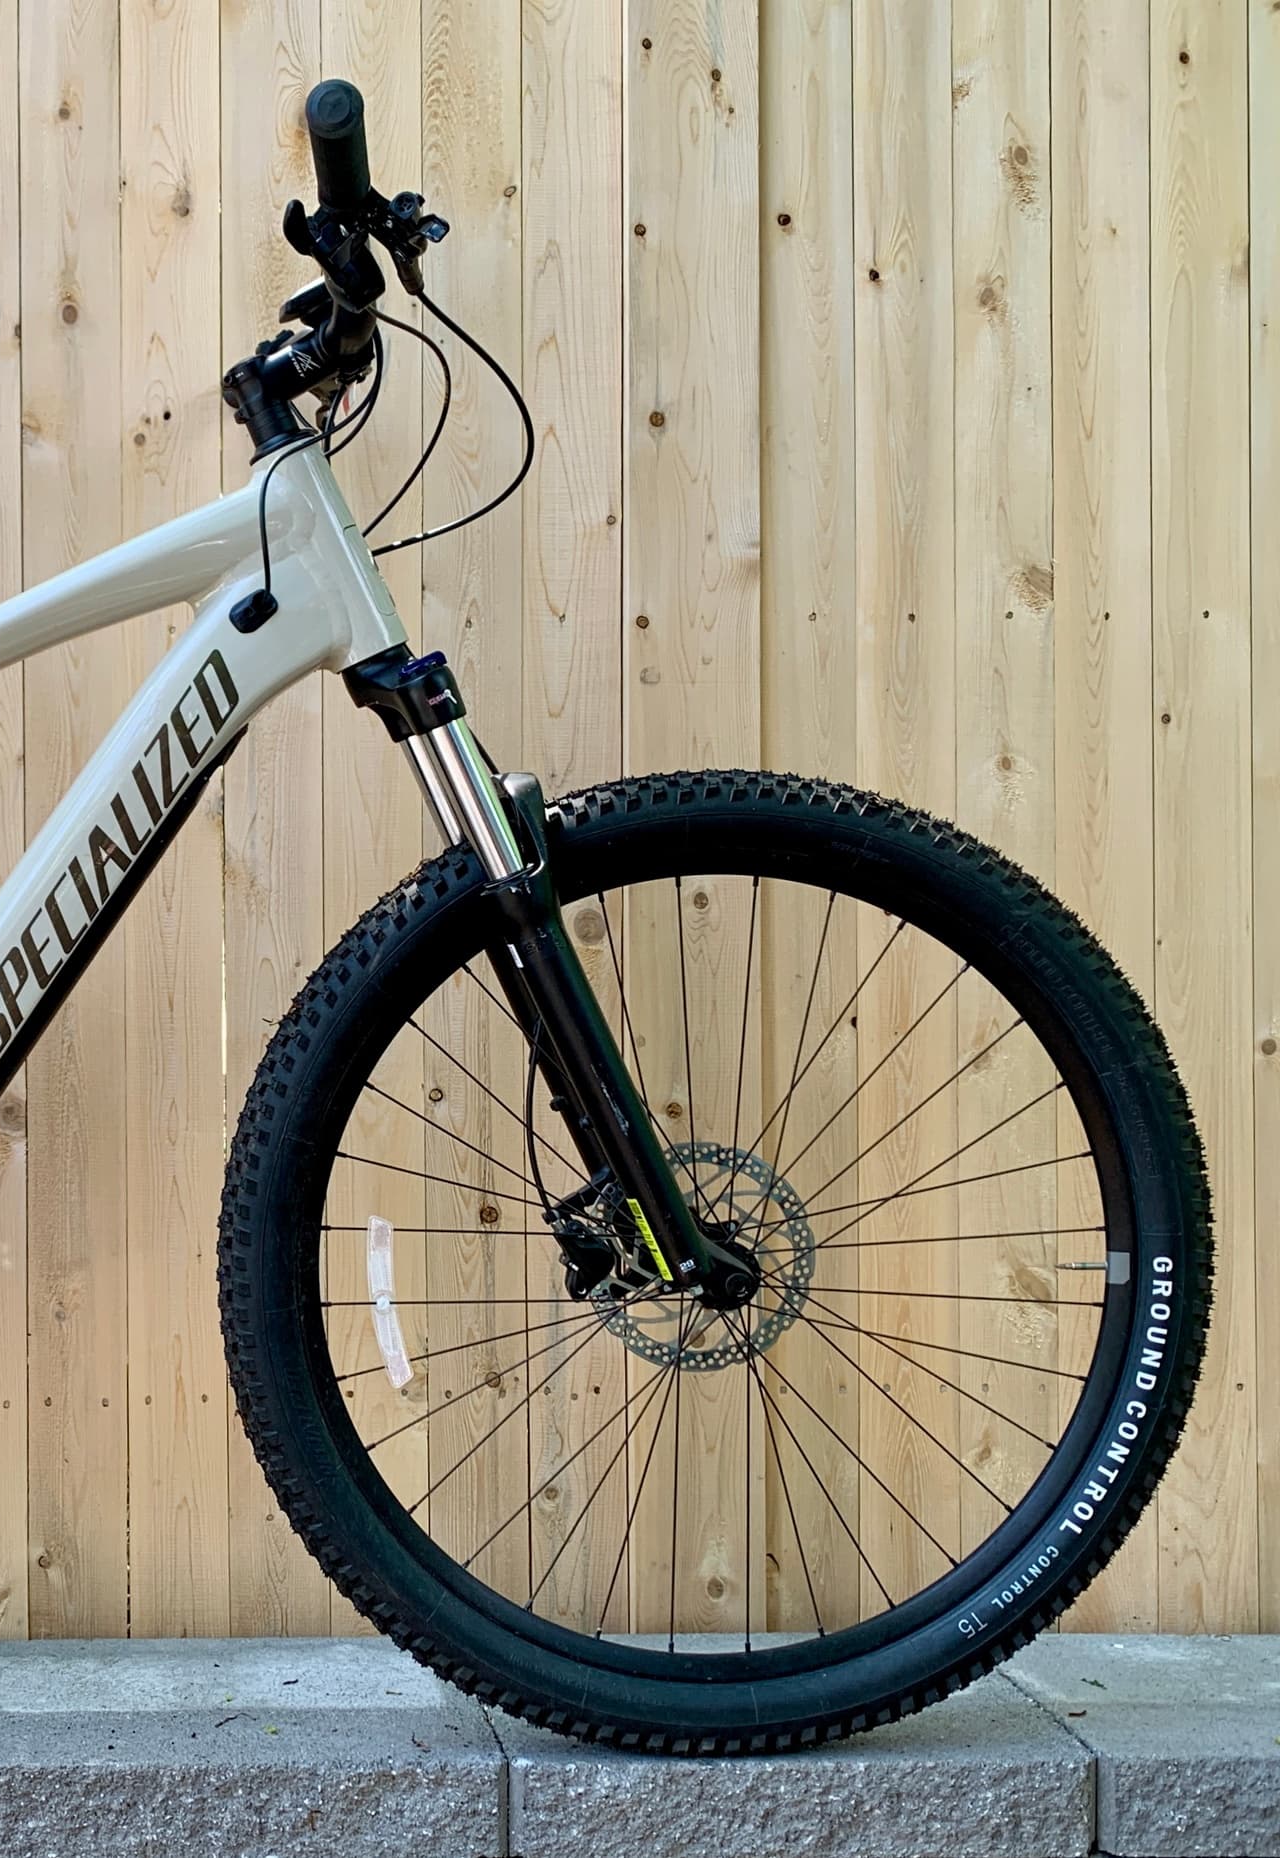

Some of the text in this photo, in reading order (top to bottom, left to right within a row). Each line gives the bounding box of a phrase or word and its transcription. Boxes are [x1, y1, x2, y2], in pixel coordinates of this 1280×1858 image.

[1059, 1255, 1173, 1535] GROUND CONTROL
[958, 1545, 1059, 1639] CONTROL T5
